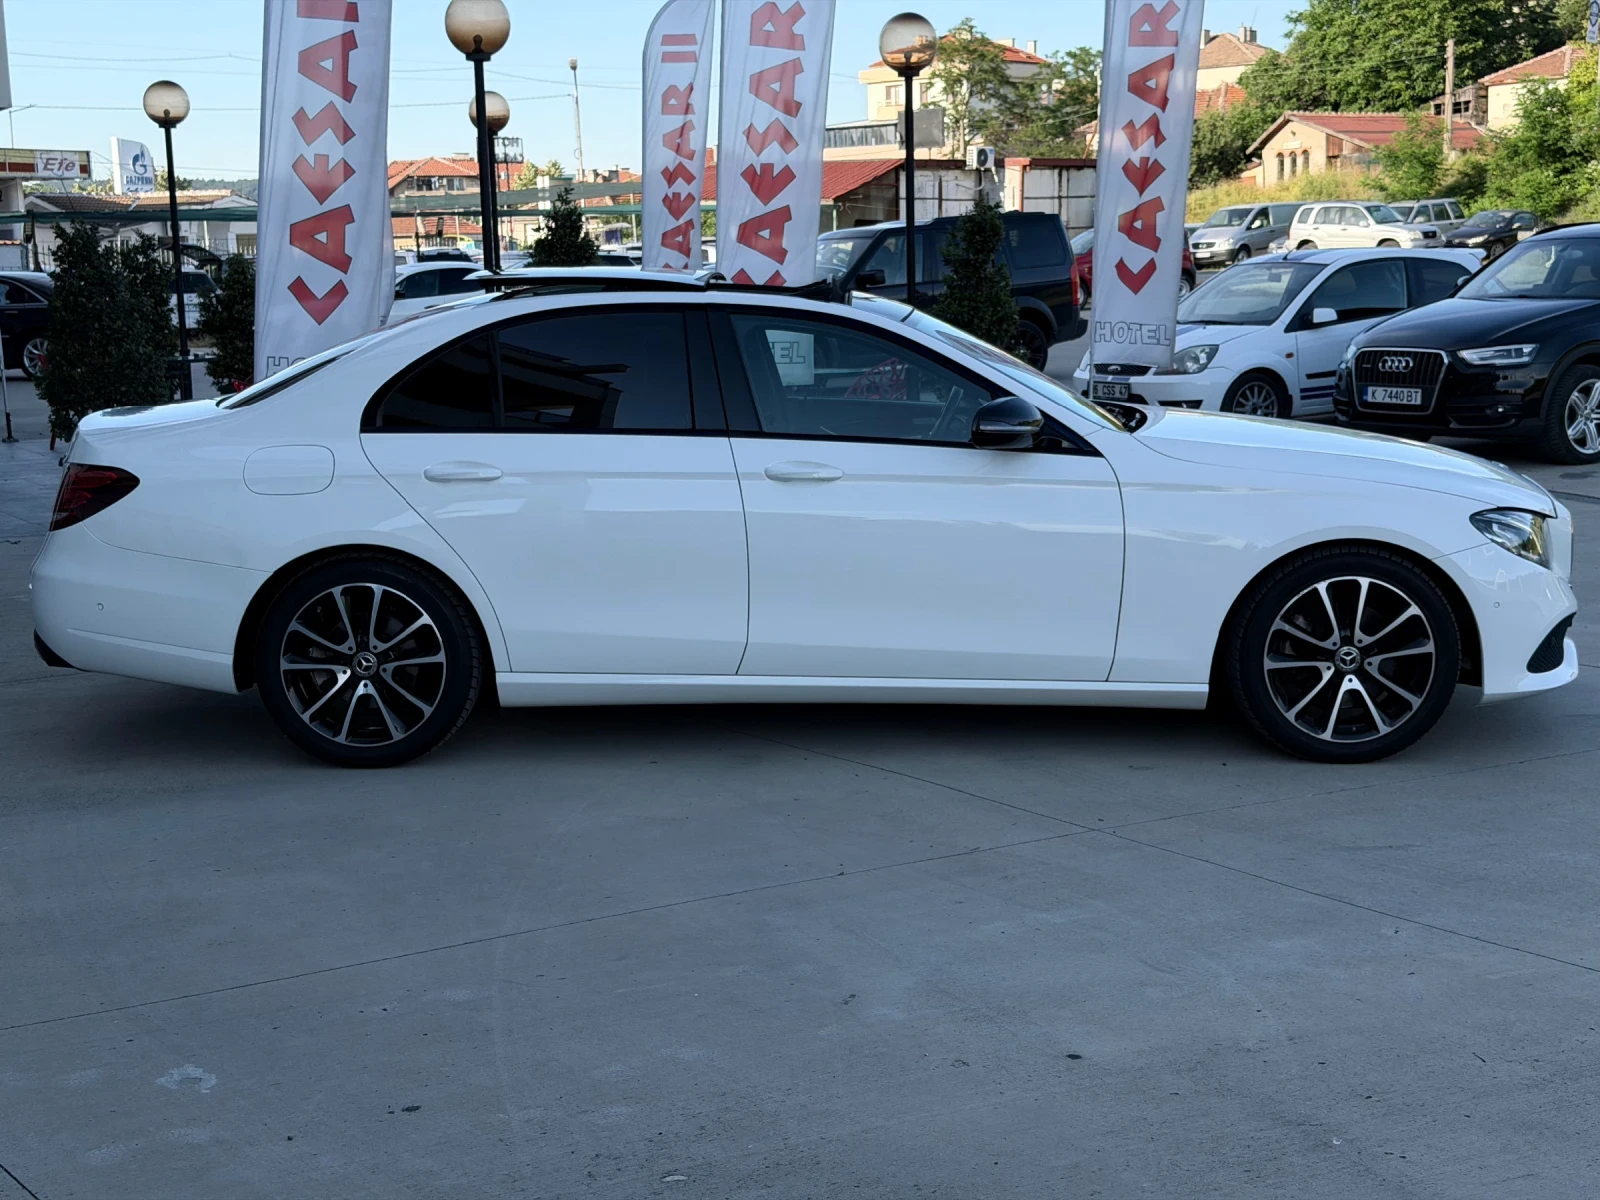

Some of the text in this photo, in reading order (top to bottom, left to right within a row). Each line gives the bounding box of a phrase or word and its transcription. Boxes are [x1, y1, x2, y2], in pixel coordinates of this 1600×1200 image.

[1115, 0, 1180, 296] CAESAR
[43, 157, 76, 172] Efe
[661, 82, 697, 269] AESAR
[1094, 321, 1172, 347] HOTEL
[1371, 388, 1378, 401] K
